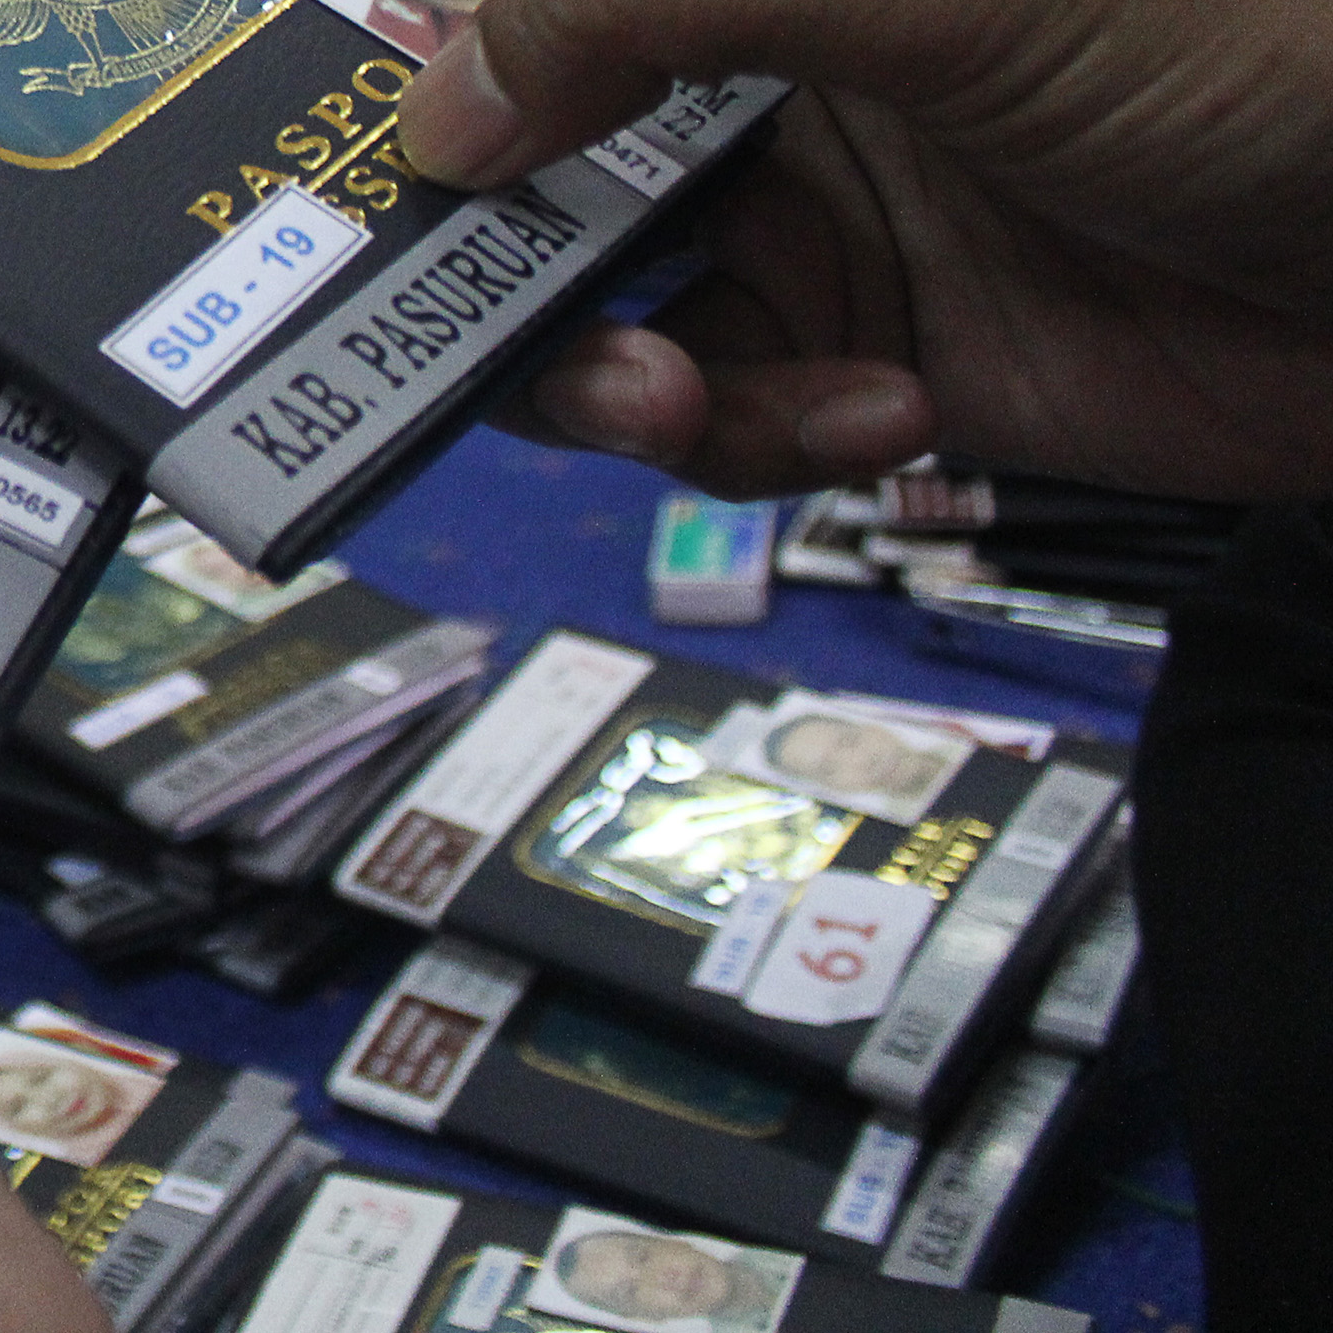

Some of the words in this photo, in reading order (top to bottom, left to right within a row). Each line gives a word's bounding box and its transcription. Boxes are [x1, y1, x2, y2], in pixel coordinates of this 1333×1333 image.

[186, 58, 415, 235] PASPO
[146, 291, 243, 374] SUB
[259, 225, 316, 273] 19
[232, 372, 377, 479] KAB.
[340, 188, 588, 389] PASURUAN
[795, 916, 879, 985] 61
